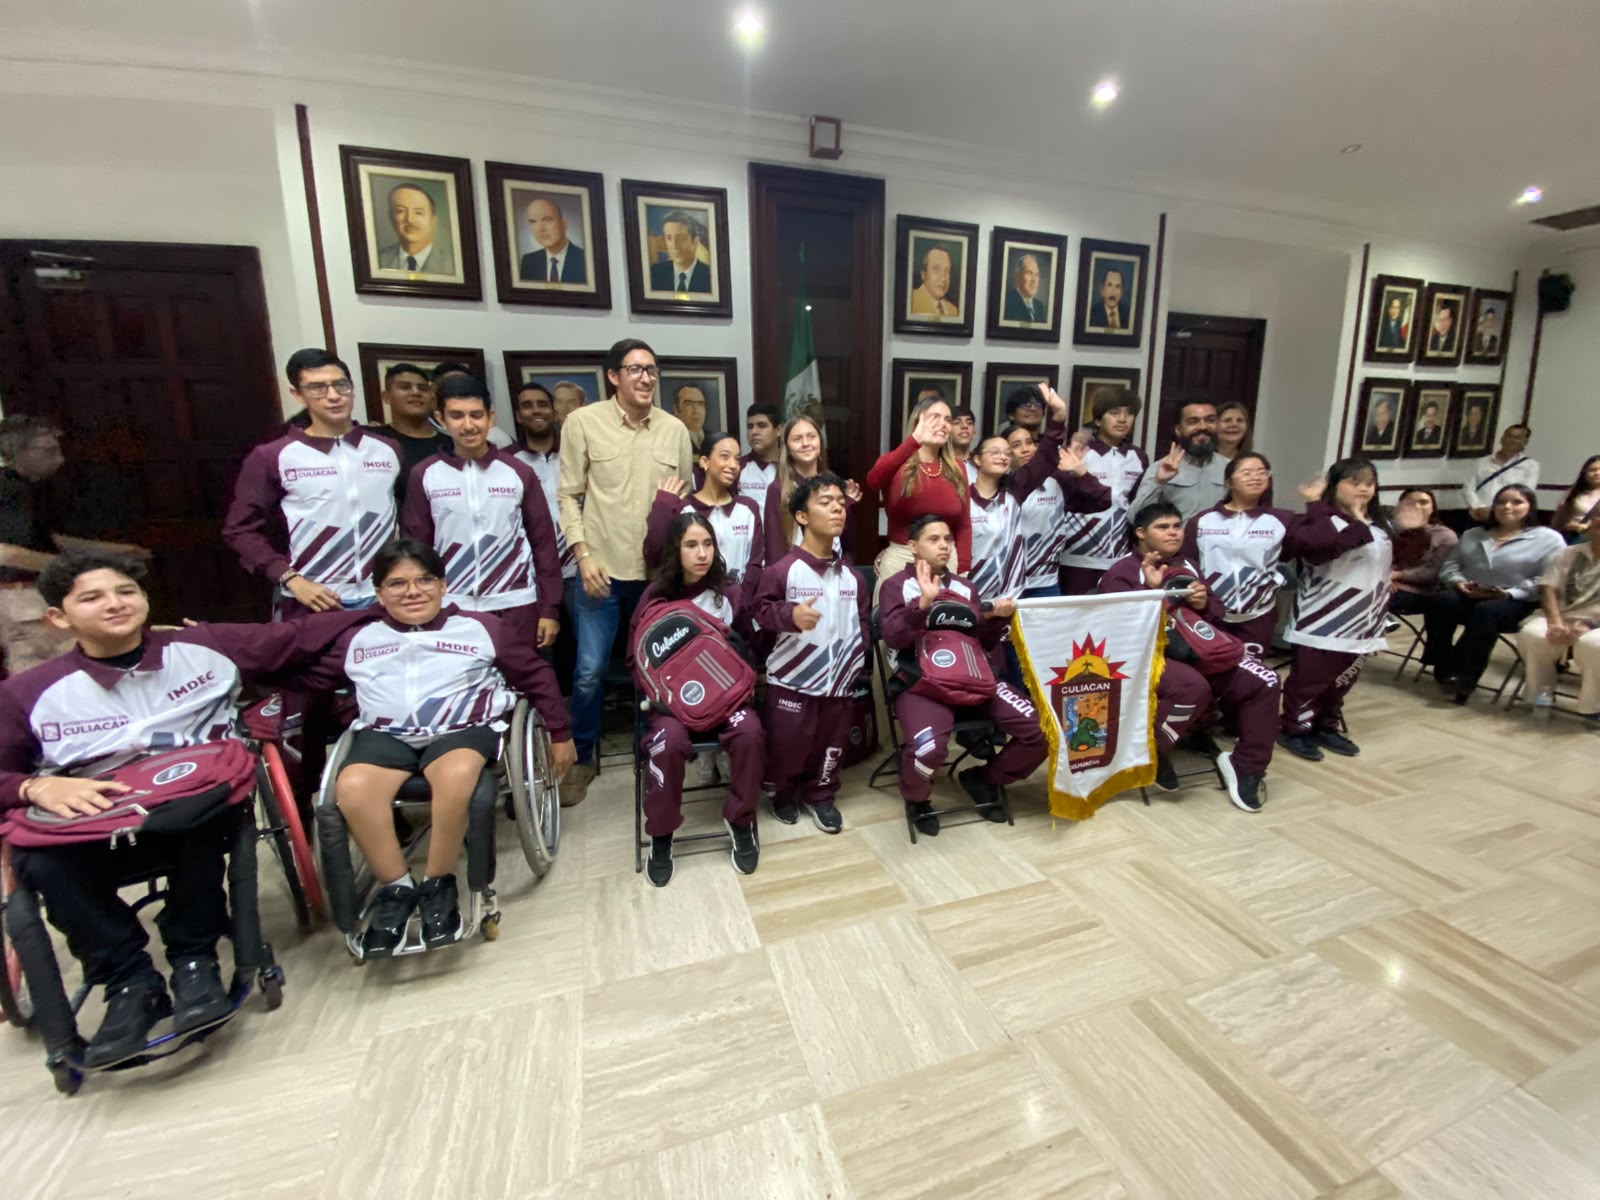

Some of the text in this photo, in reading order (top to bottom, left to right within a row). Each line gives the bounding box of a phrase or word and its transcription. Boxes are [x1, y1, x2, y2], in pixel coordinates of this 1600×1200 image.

[362, 461, 393, 469] IMDEC
[487, 487, 516, 495] IMDEC
[436, 640, 479, 654] IMDEC
[167, 670, 215, 701] IMDEC
[1061, 682, 1111, 694] CULIACAN
